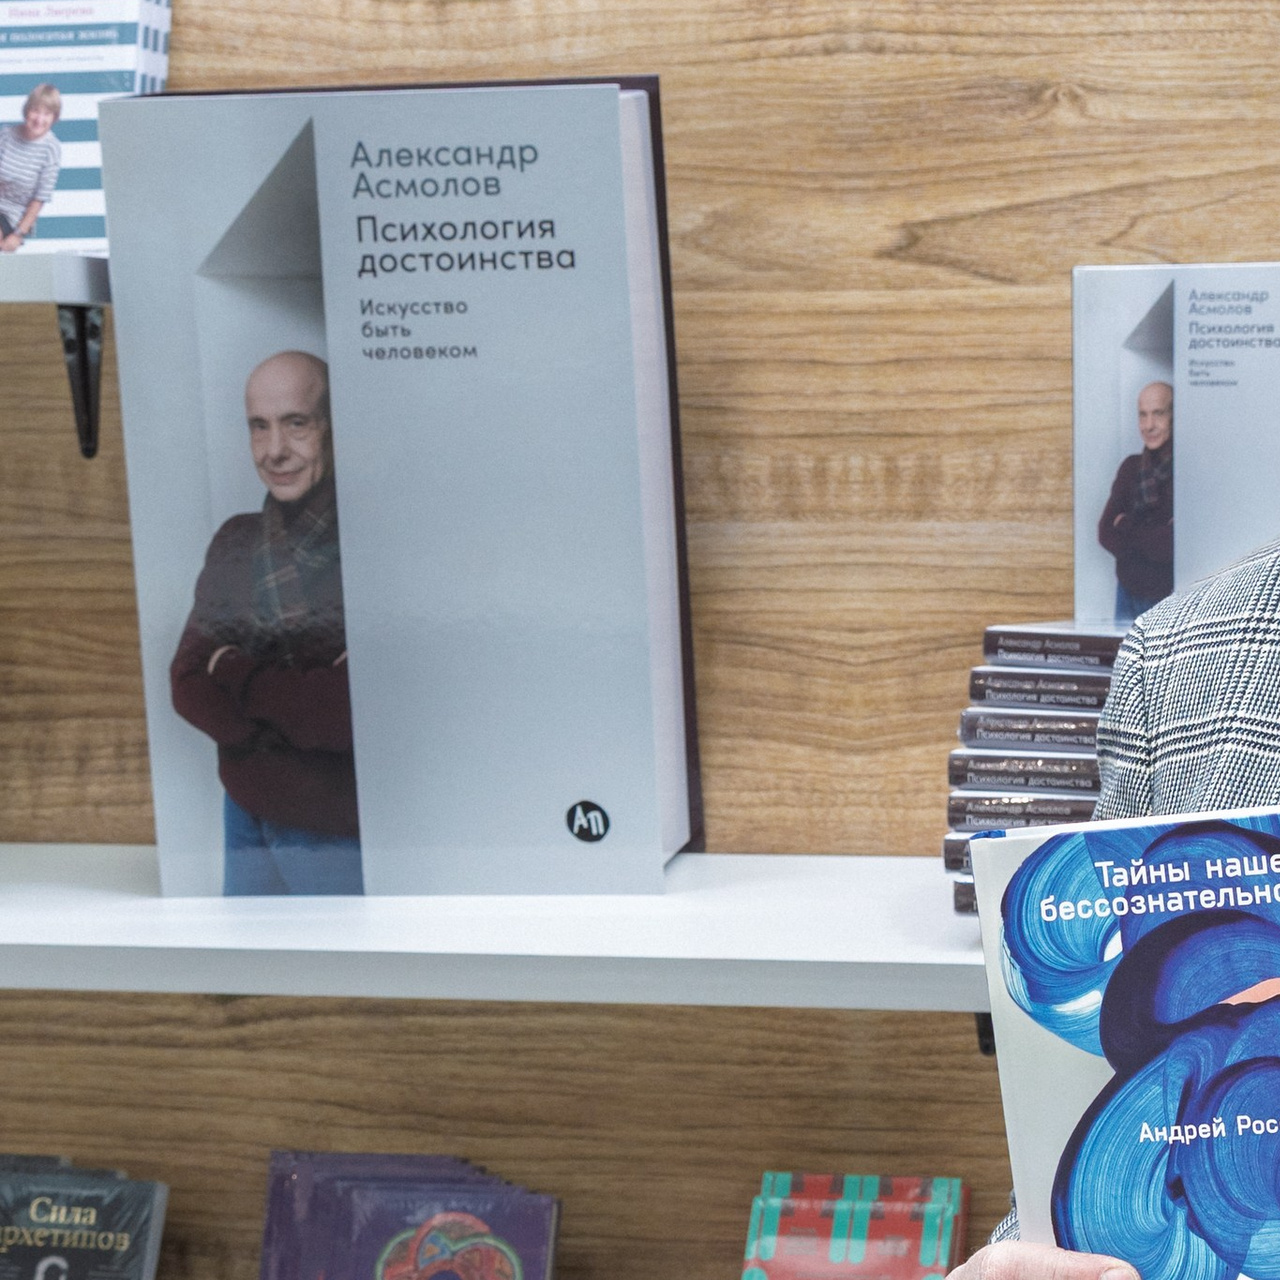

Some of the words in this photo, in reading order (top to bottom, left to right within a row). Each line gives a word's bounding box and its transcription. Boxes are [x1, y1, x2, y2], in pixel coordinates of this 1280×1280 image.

[349, 140, 540, 173] Александр
[351, 171, 502, 200] Асмолов
[356, 215, 557, 246] Психология
[357, 246, 577, 279] достоинства
[360, 298, 469, 319] Искусство
[1189, 289, 1270, 304] Александр
[1189, 302, 1252, 316] Асмолов
[361, 322, 412, 340] быть
[1189, 321, 1275, 335] Психология
[362, 343, 479, 362] человеком
[1094, 856, 1190, 889] Тайны
[1139, 1117, 1227, 1147] Андрей
[29, 1195, 98, 1227] Сила
[0, 1222, 131, 1254] рхетипов
